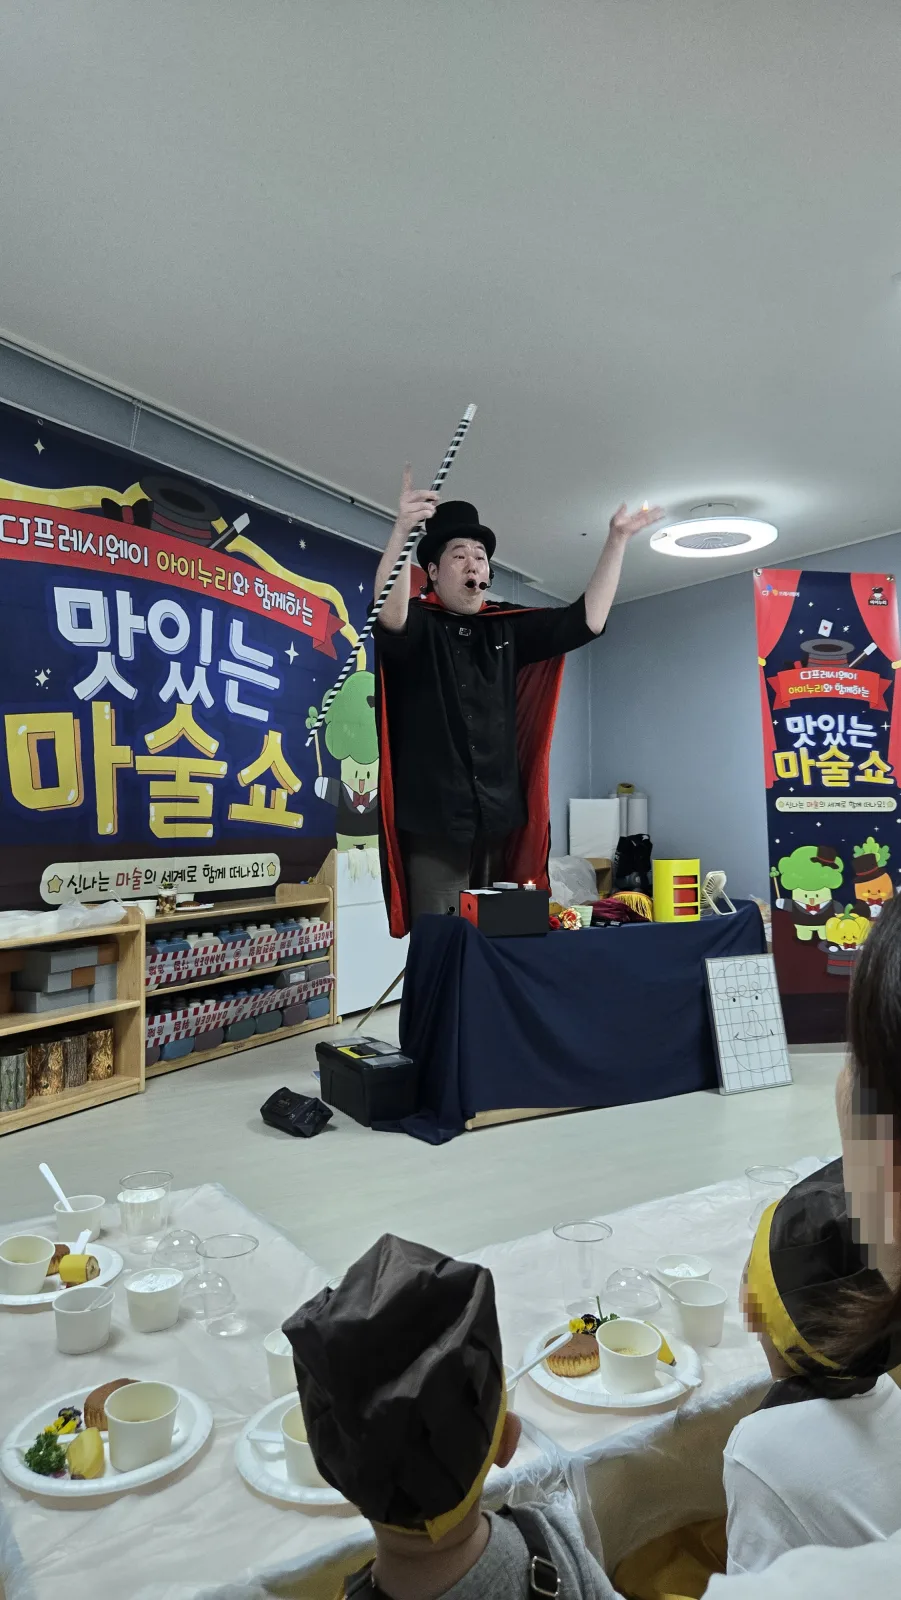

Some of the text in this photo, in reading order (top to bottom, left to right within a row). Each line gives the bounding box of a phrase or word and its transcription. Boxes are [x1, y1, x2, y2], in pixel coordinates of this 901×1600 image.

[0, 514, 313, 626] CJ프레시웨이 아이누리와 함께하는
[54, 586, 281, 722] 맛있는
[800, 669, 857, 680] CJ프레시웨이
[788, 682, 870, 698] 아이누리와 함께하는
[785, 713, 878, 749] 맛있는
[5, 700, 304, 839] 마술쇼
[774, 745, 895, 787] 마술쇼
[785, 801, 804, 809] 신나는
[66, 861, 265, 895] 신나는 마술의 세계로 함께 떠나요!
[314, 931, 333, 942] ANGER
[194, 953, 226, 967] DANGER
[173, 1019, 190, 1032] 위험
[195, 1010, 229, 1026] DANGER
